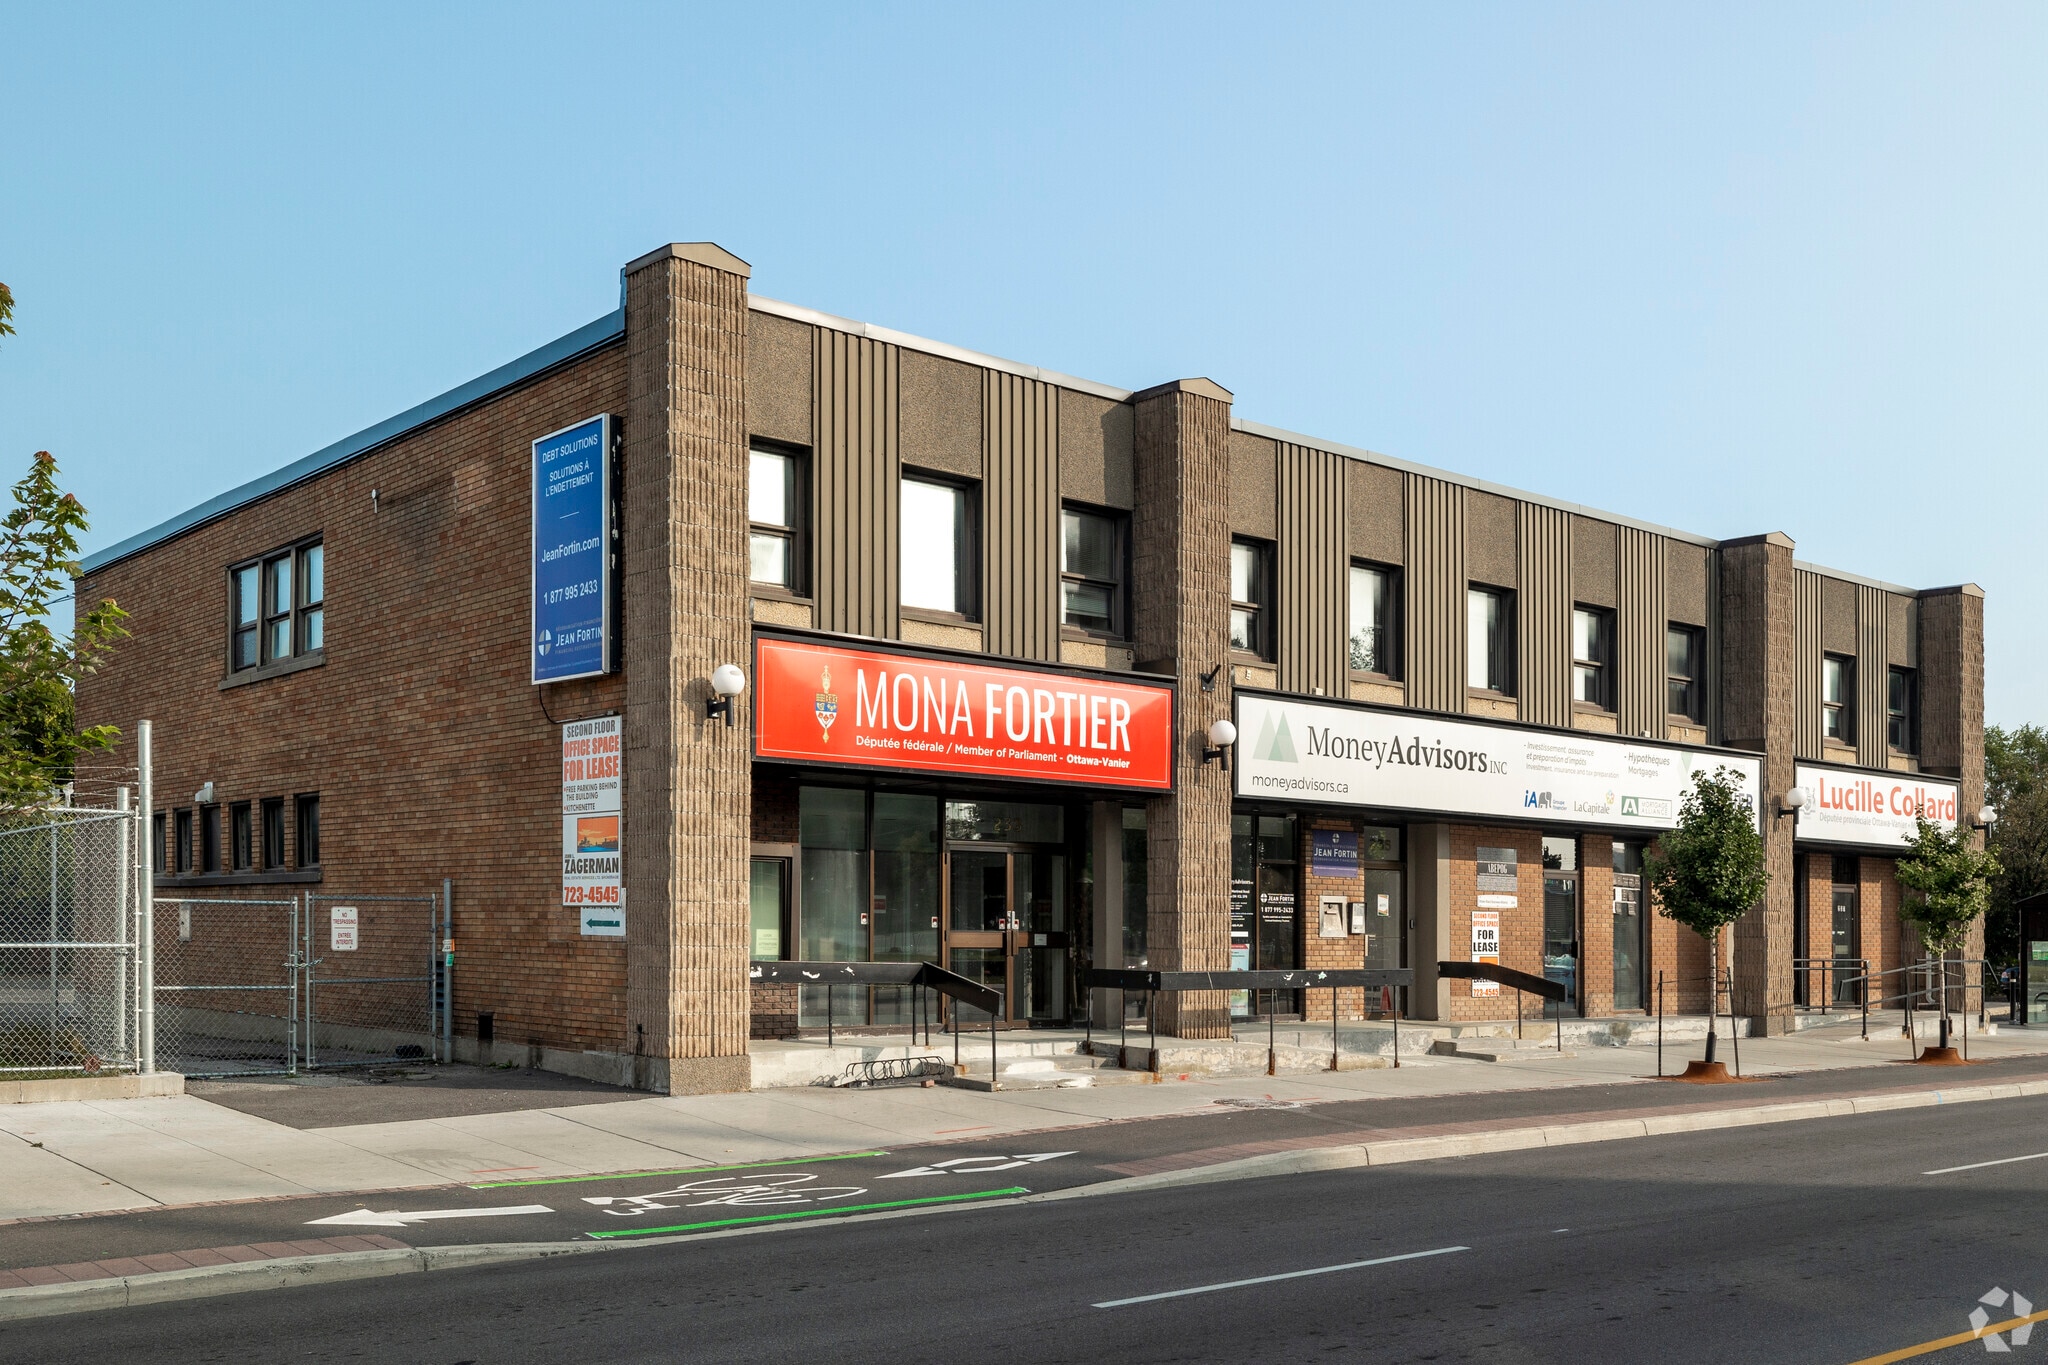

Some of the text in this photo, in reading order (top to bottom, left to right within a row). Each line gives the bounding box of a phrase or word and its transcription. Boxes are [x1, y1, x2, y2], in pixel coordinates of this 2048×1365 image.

[542, 434, 598, 464] DEBT SOLUTIONS
[550, 458, 590, 482] SOLUTIONS À
[546, 472, 594, 497] L'ENDETTEMENT
[542, 536, 600, 562] JeanFortin.com
[544, 580, 598, 605] 1 877 995 2433
[556, 632, 574, 646] JEAN
[577, 626, 602, 642] FORTIN
[856, 668, 1131, 752] MONA FORTIER
[567, 720, 615, 738] SECOND FLOOR
[564, 735, 619, 758] OFFICE SPACE
[856, 735, 900, 749] Députée
[903, 739, 944, 752] fédérale
[954, 744, 994, 757] Member
[996, 748, 1006, 758] of
[1008, 748, 1058, 762] Parliament
[1066, 754, 1130, 768] Ottawa-Vanier
[1306, 725, 1508, 775] MoneyAdvisors INC
[1568, 747, 1594, 756] assurance
[564, 755, 619, 782] FOR LEASE
[1628, 766, 1658, 778] Mortgages
[577, 784, 597, 792] PARKING
[599, 782, 617, 790] BEHIND
[1252, 774, 1349, 794] moneyadvisors.ca
[576, 792, 598, 801] BUILDING
[1820, 778, 1955, 821] Lucille Collard
[566, 803, 595, 812] KITCHENETTE
[1820, 812, 1842, 824] Députée
[1314, 848, 1357, 858] JEAN FORTIN
[564, 857, 619, 874] ZAGERMAN
[564, 886, 618, 903] 723-4545
[1478, 930, 1494, 940] FOR
[1473, 942, 1498, 952] LEASE
